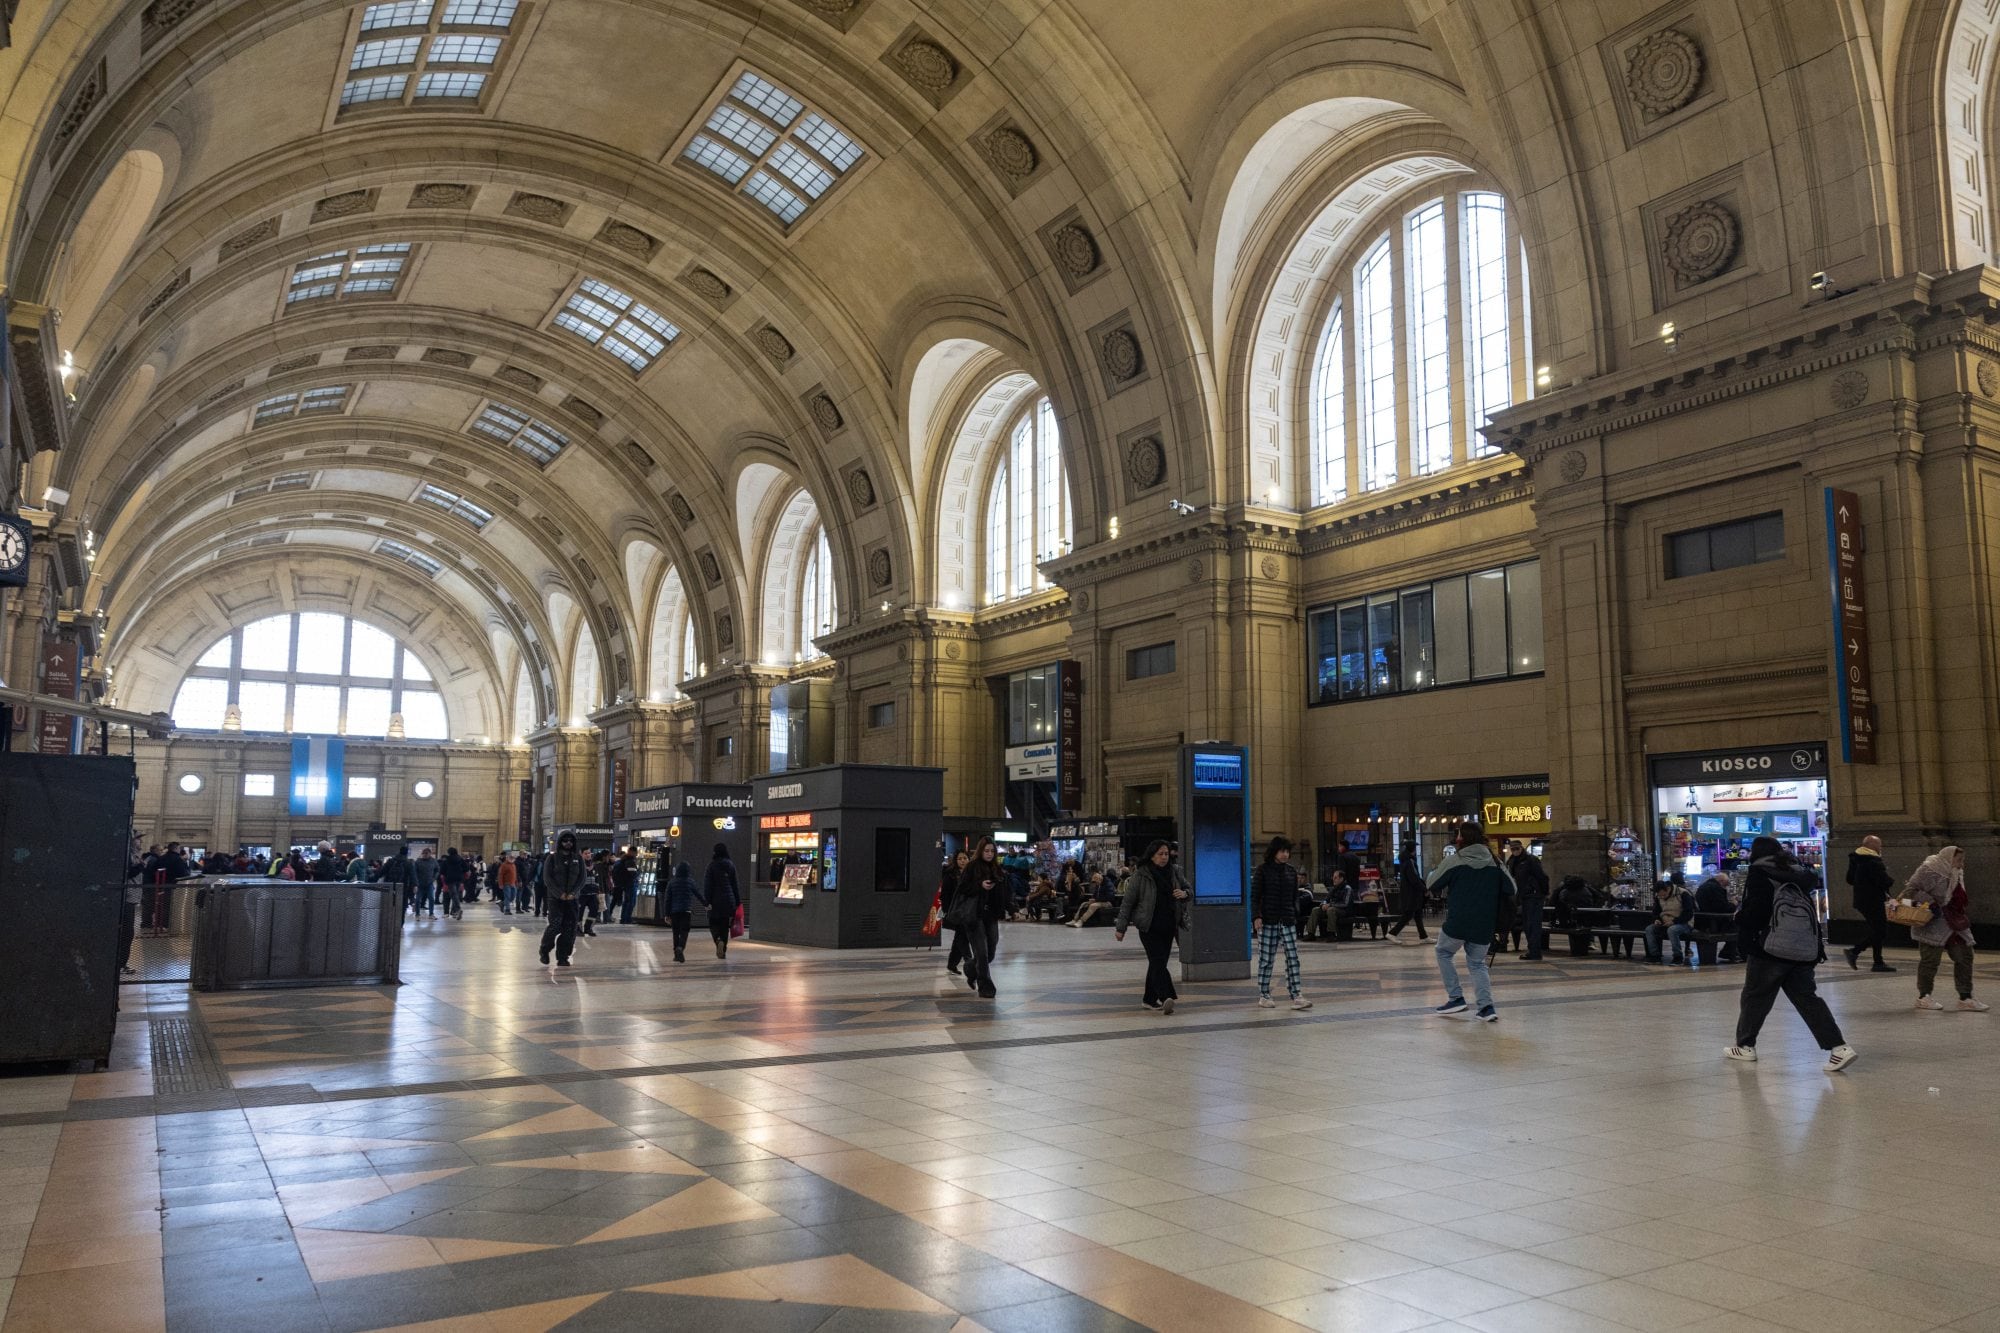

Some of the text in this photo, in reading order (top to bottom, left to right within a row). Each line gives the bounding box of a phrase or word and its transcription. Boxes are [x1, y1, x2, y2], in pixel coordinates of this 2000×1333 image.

[1023, 745, 1052, 758] Comando
[1702, 756, 1772, 772] KIOSCO
[1507, 782, 1523, 790] show
[1524, 781, 1532, 789] de
[635, 792, 670, 813] Panadería
[1505, 806, 1541, 822] PAPAS
[372, 833, 402, 841] KIOSCO
